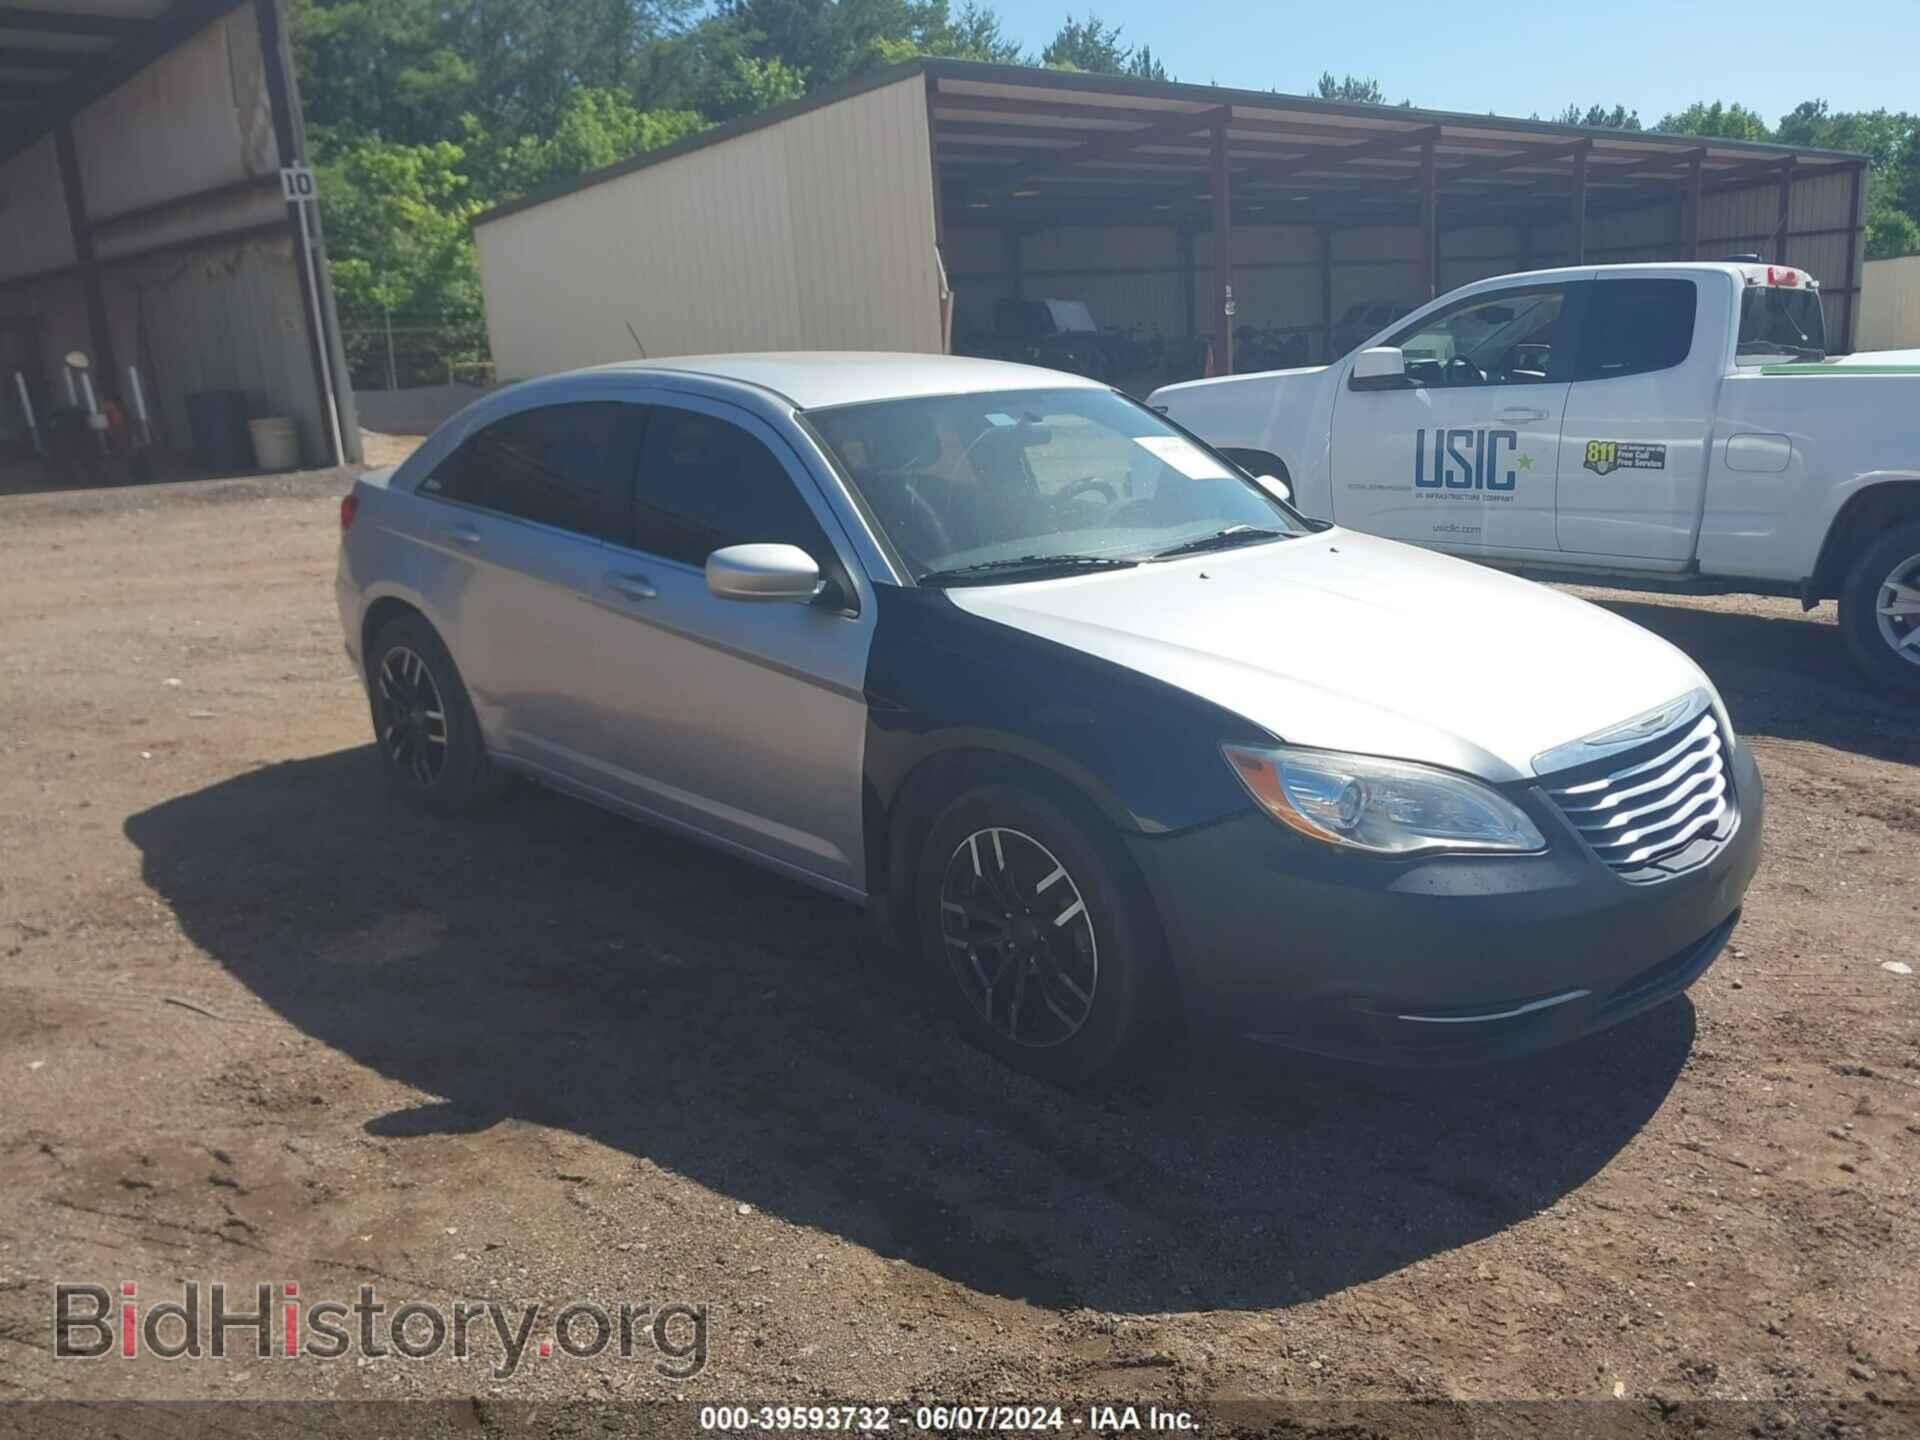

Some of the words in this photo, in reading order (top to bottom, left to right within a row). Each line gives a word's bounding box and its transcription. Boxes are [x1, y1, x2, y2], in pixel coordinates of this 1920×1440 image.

[286, 173, 312, 194] 10
[1415, 429, 1517, 490] USIC
[1587, 441, 1616, 464] 811
[1617, 451, 1633, 459] Free
[1635, 451, 1650, 459] Call
[1635, 459, 1663, 468] Service
